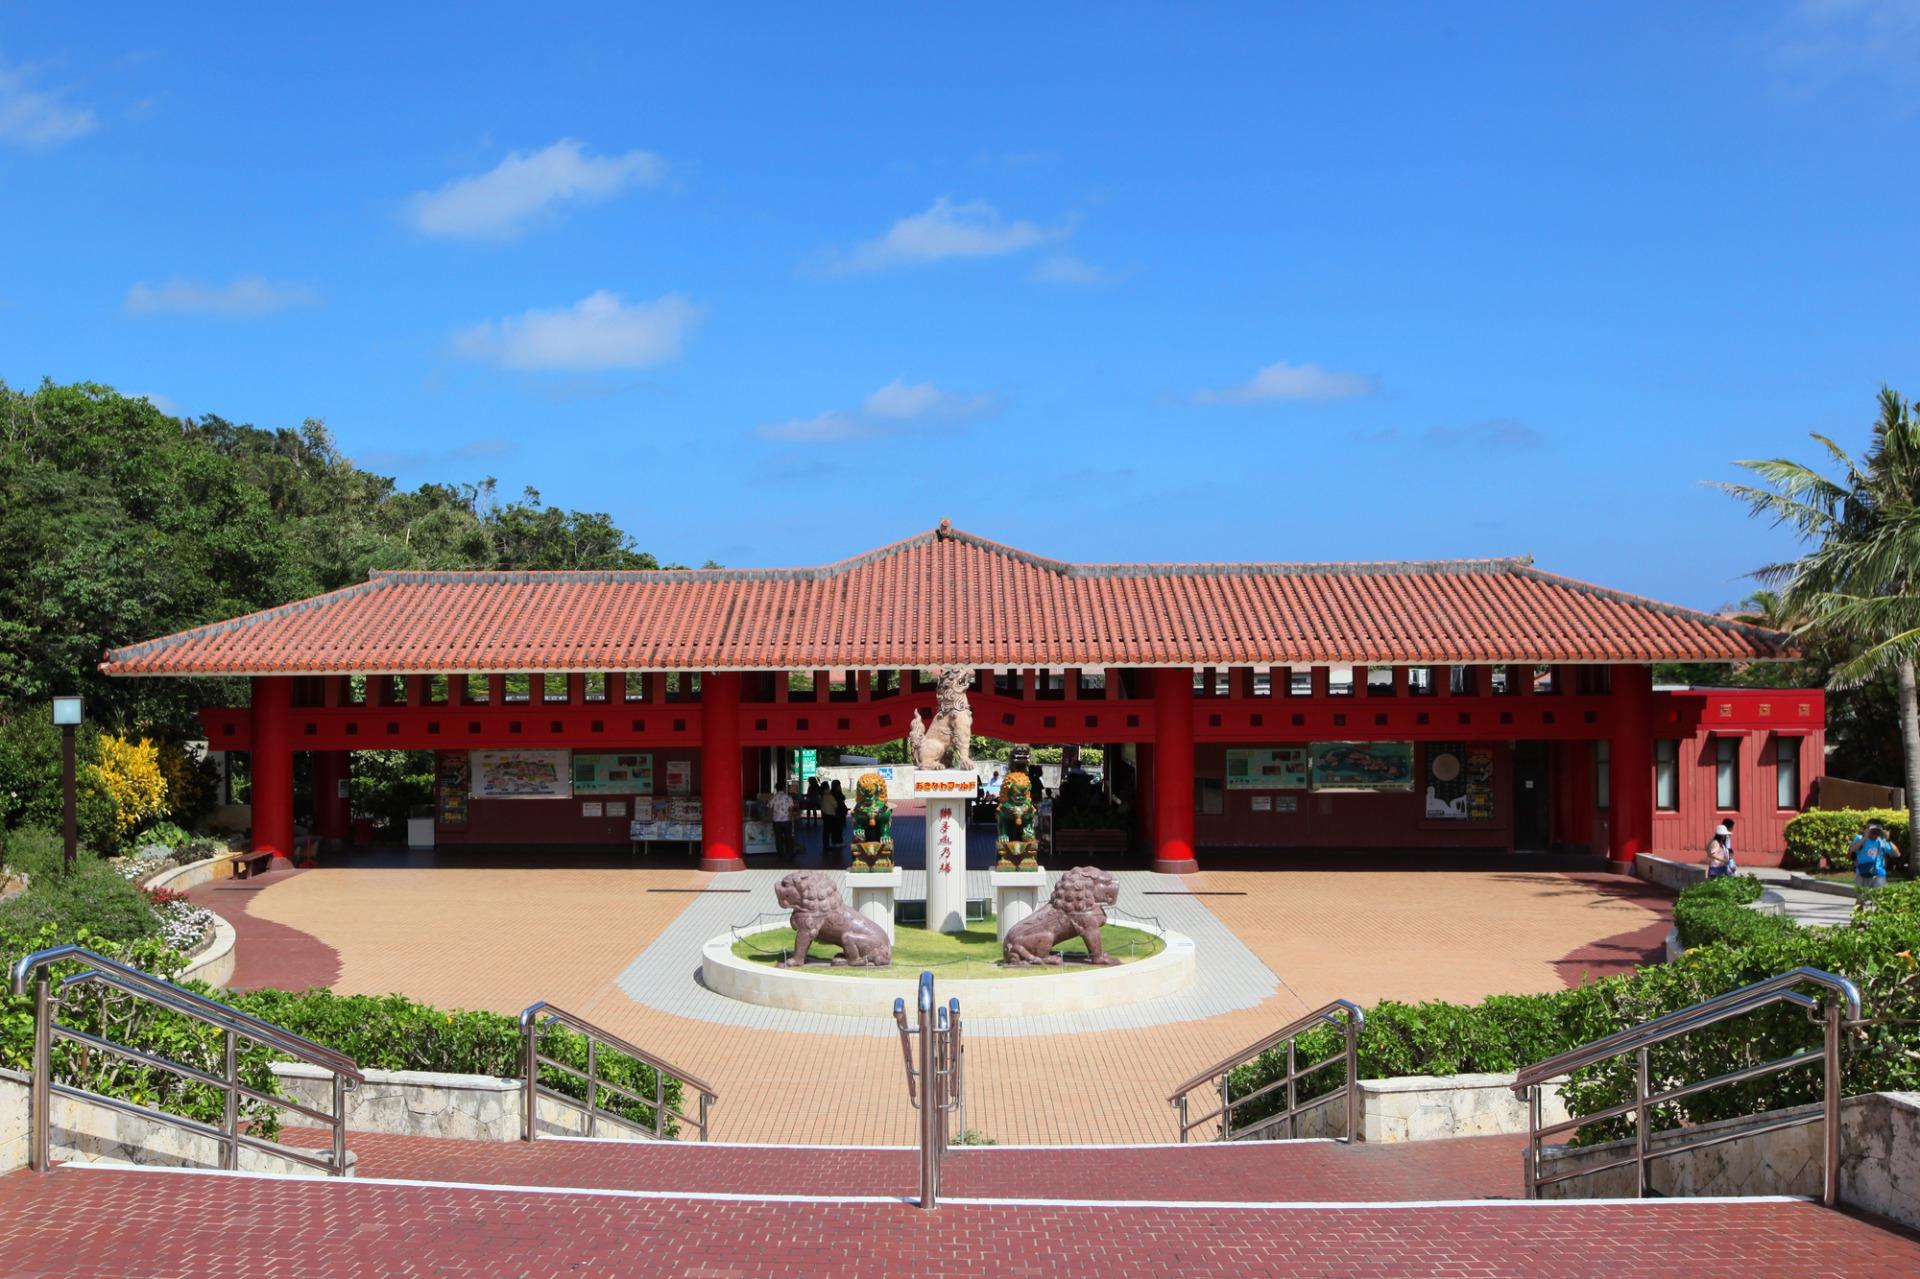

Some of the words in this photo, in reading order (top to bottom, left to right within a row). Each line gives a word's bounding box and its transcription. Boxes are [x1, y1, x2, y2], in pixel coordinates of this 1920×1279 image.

[916, 781, 976, 792] おきなわワールド
